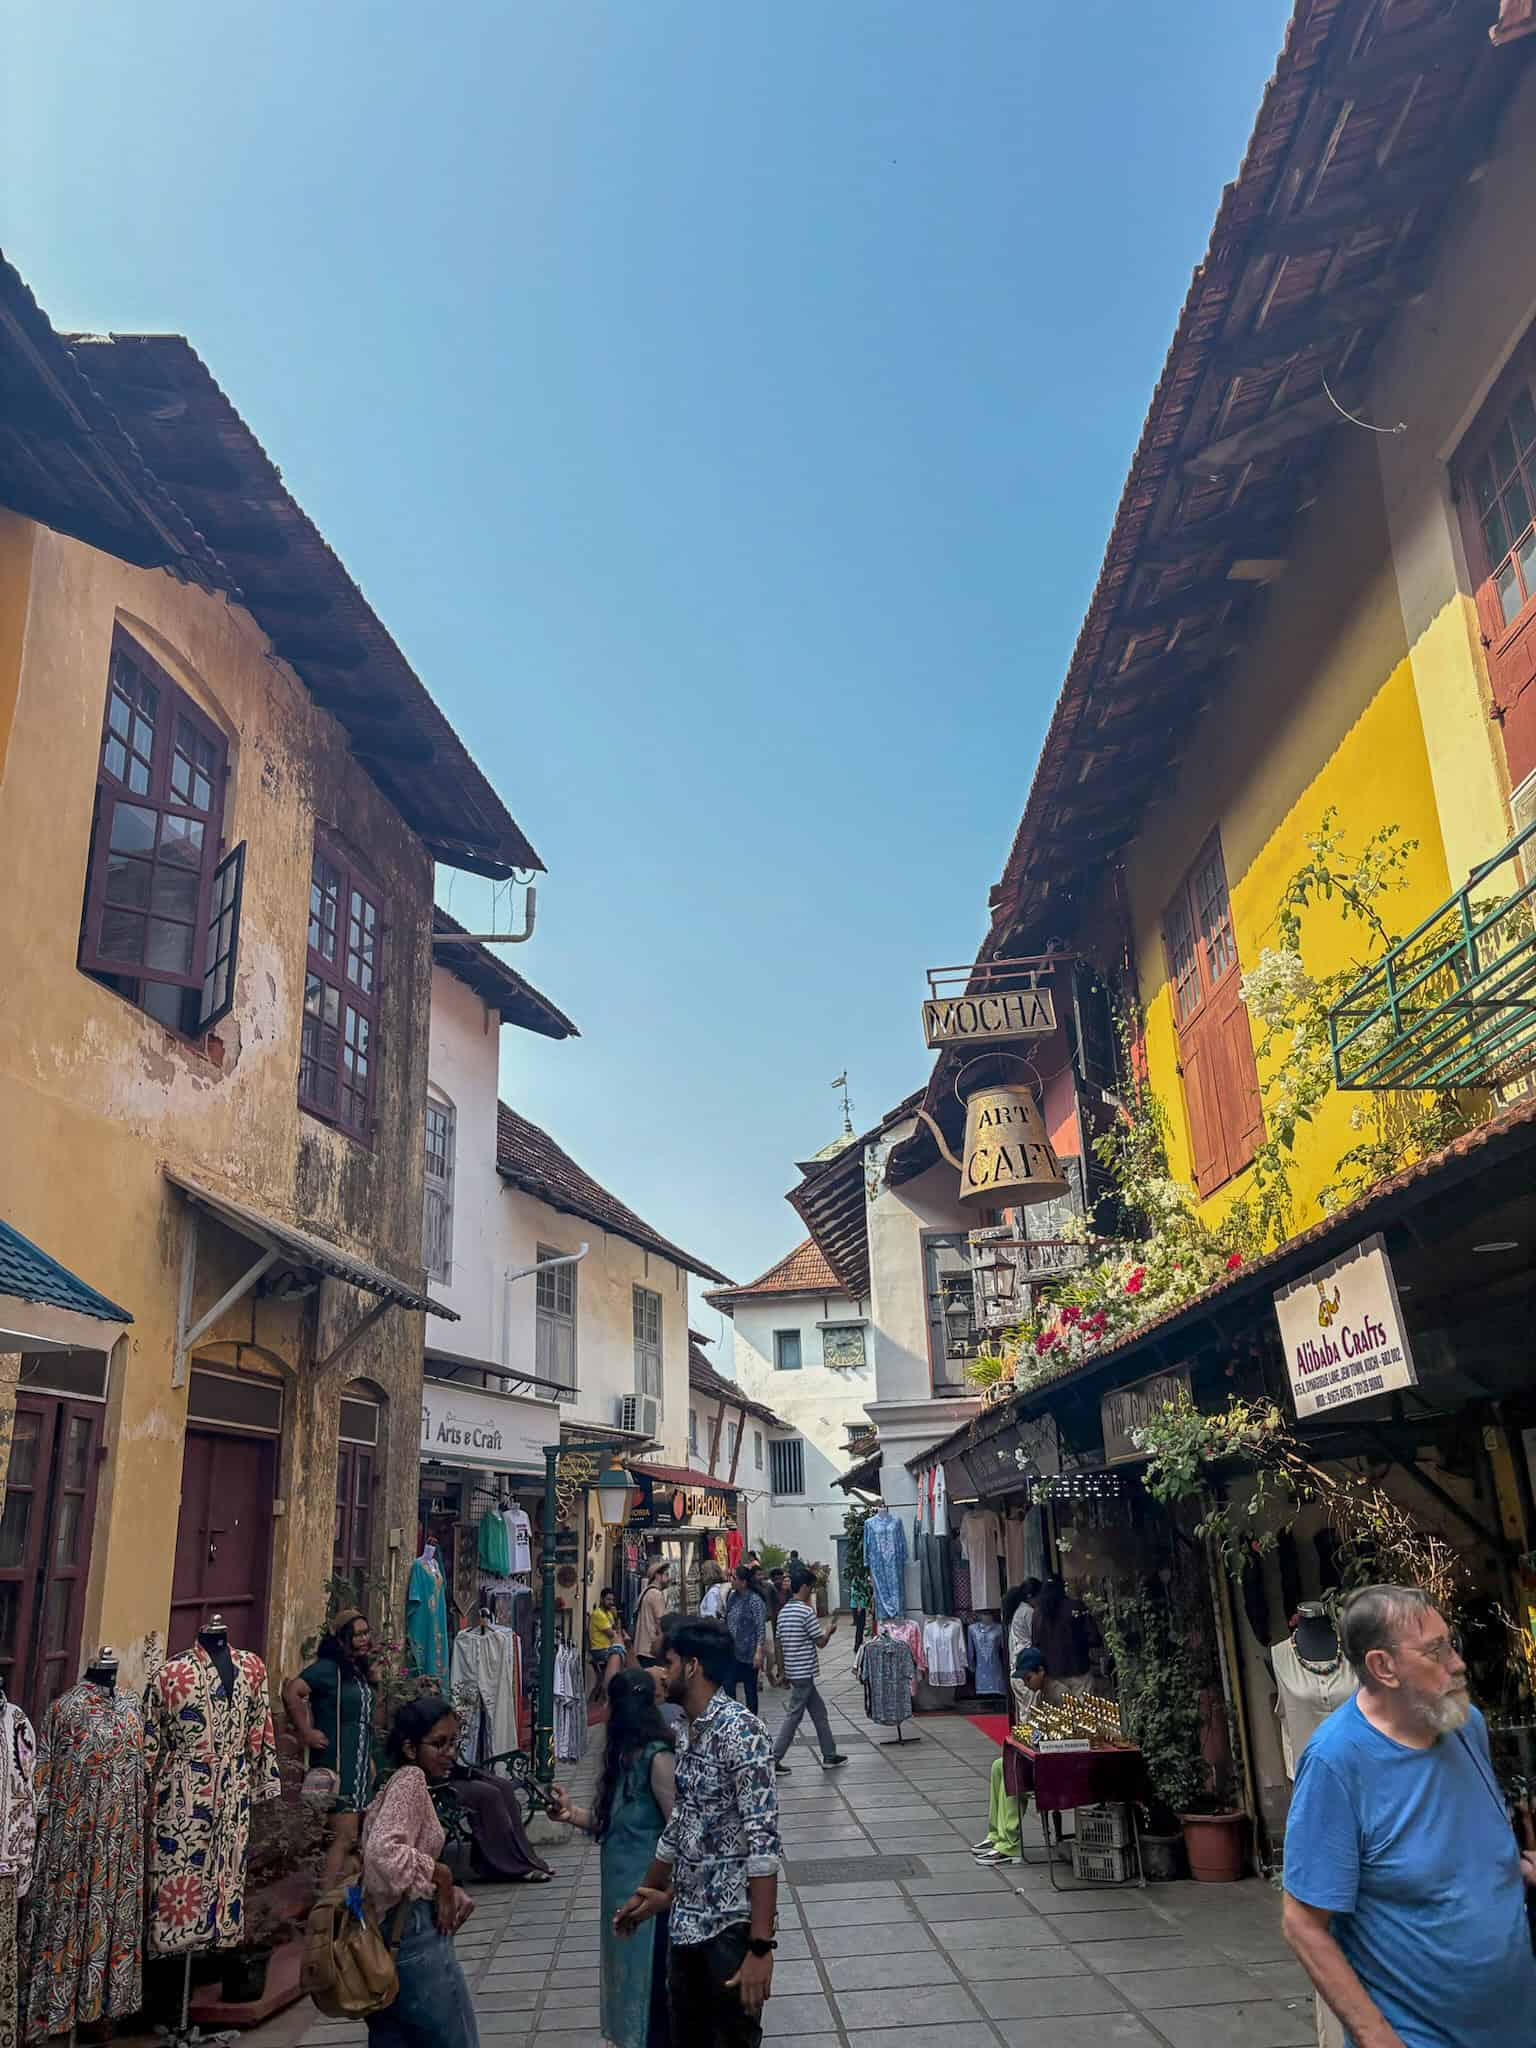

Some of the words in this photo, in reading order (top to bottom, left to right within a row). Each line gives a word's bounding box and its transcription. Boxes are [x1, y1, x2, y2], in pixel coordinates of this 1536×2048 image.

[928, 994, 1051, 1038] MOCHA
[978, 1105, 1031, 1129] ART
[1296, 1334, 1341, 1377] Alibaba
[436, 1421, 461, 1445] Arts
[472, 1428, 503, 1451] Craft
[685, 1491, 728, 1518] EUPHORIA
